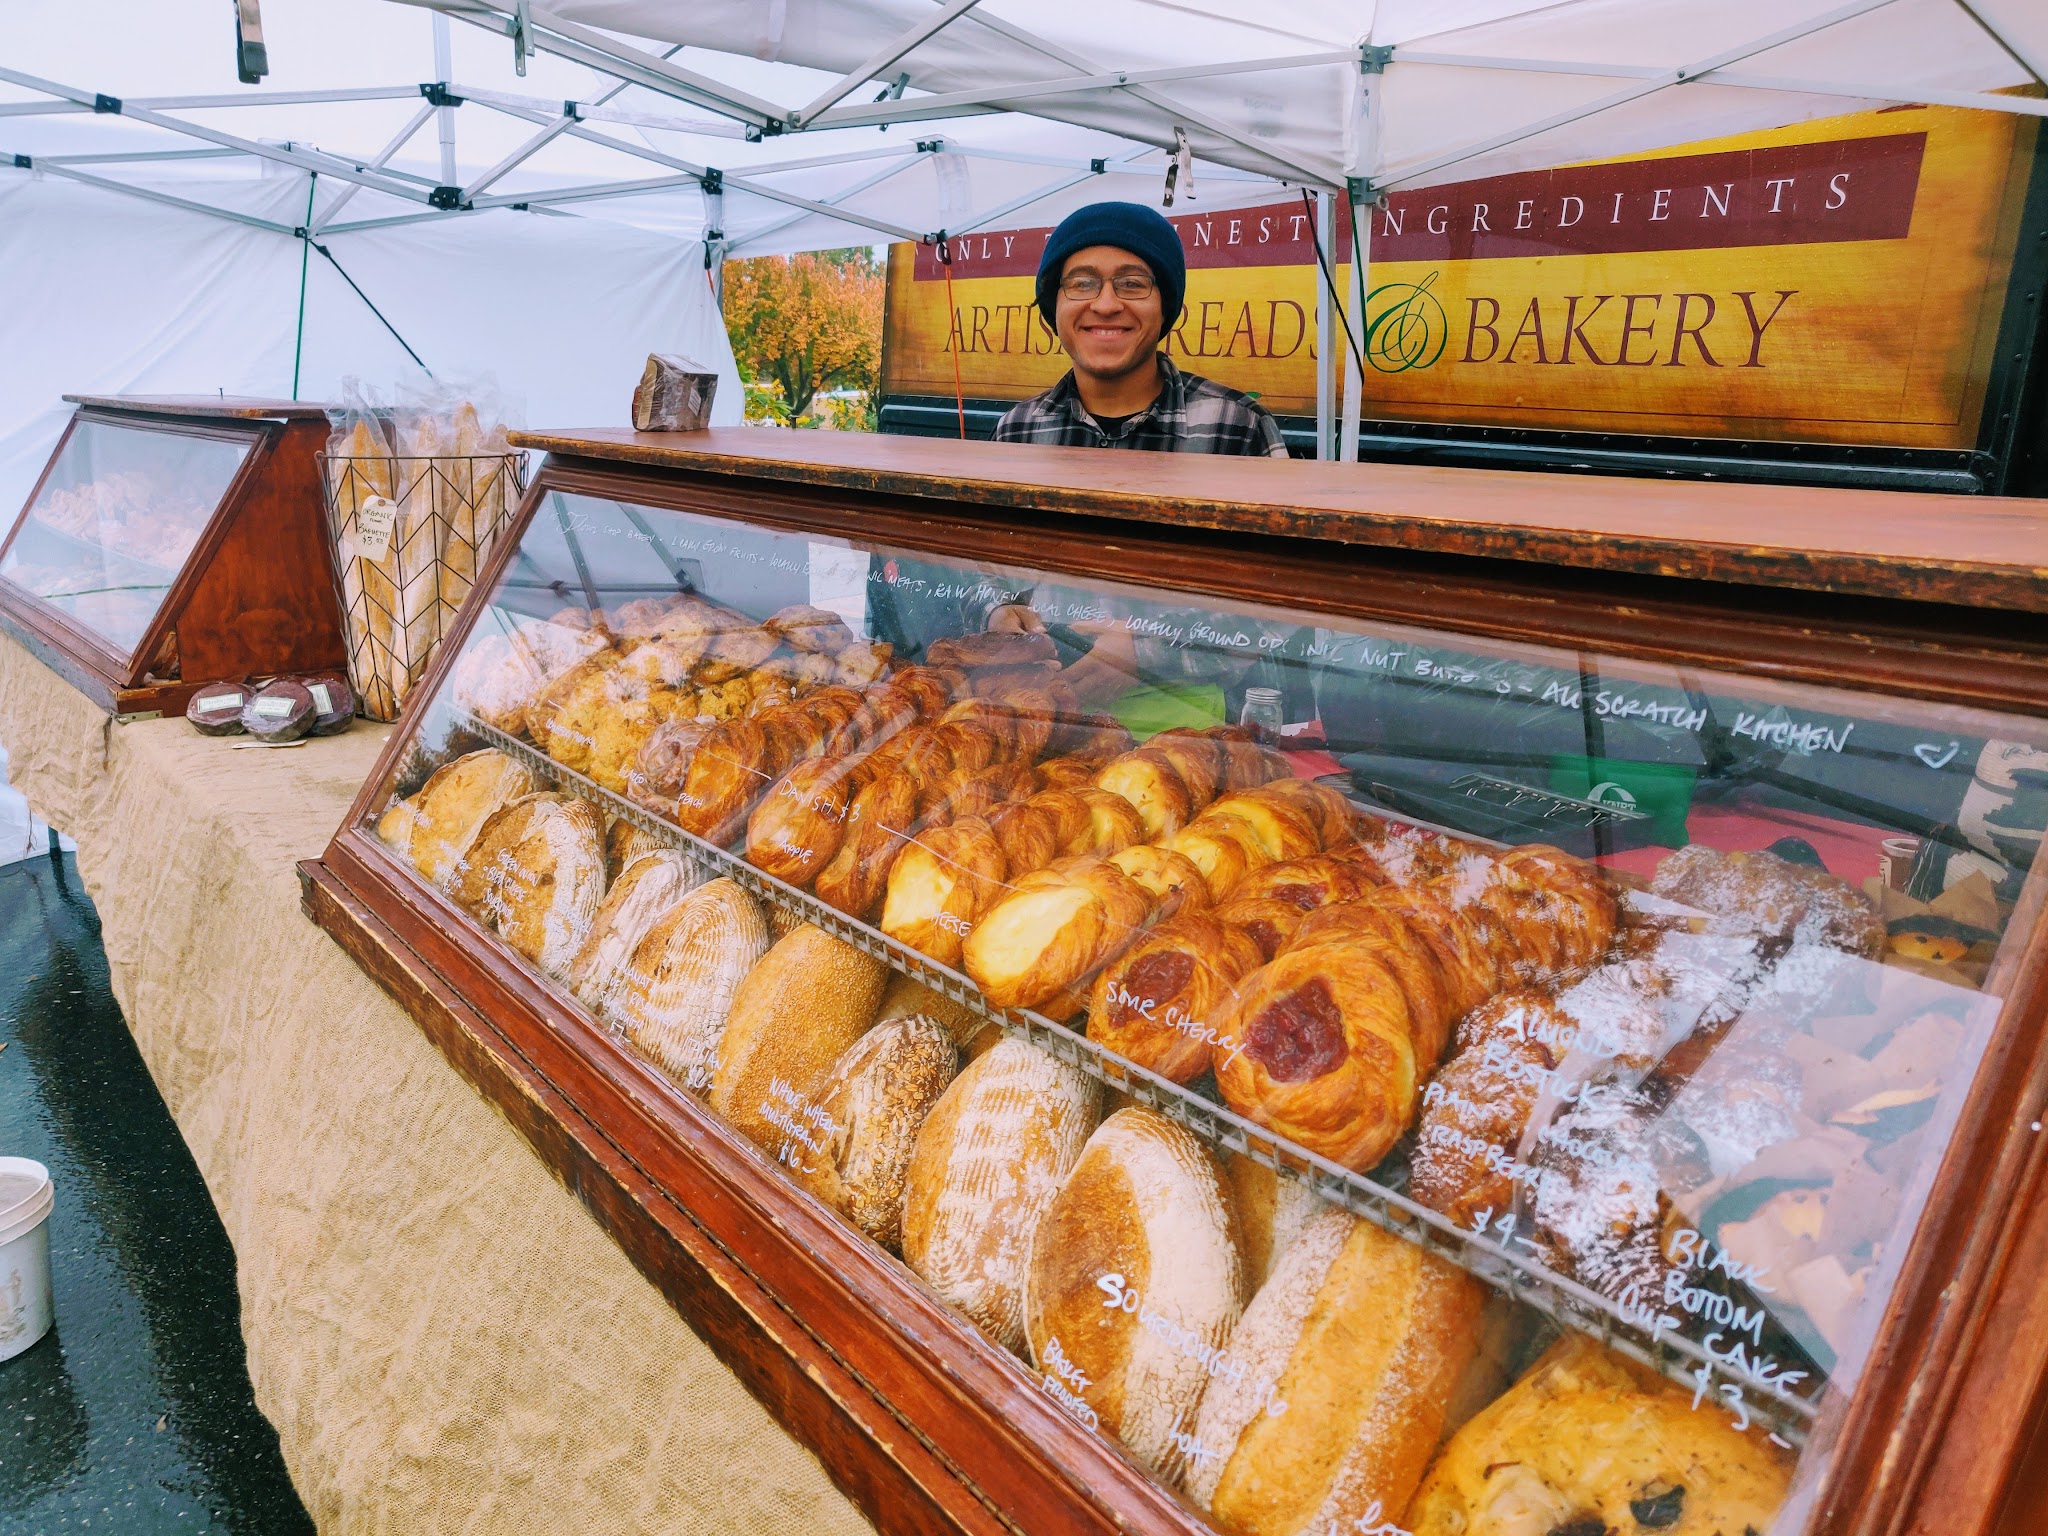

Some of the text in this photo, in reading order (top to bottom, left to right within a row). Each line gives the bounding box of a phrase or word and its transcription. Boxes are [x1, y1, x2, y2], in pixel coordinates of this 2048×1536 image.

[935, 172, 1850, 262] ONLY NEST NGREDIENTS
[942, 304, 1063, 356] ARTIS
[1166, 300, 1318, 360] READ
[1460, 290, 1799, 368] BAKERY
[1190, 622, 1251, 647] GROUND
[1360, 648, 1407, 671] NUT
[1595, 690, 1707, 732] SCRATCH
[1732, 713, 1854, 753] KITCHEN
[779, 779, 861, 824] DANISH $3
[779, 837, 814, 865] APPLE
[1105, 981, 1247, 1071] SOUR CHERRY
[1497, 1008, 1620, 1058] ALMOND
[1482, 1041, 1606, 1111] BOSTOCK
[1431, 1125, 1546, 1189] RASPBERR
[1668, 1229, 1777, 1294] BLACK
[1096, 1273, 1248, 1387] SOURDOUGH
[1664, 1269, 1766, 1347] BOTTOM
[1703, 1333, 1809, 1397] CAKE
